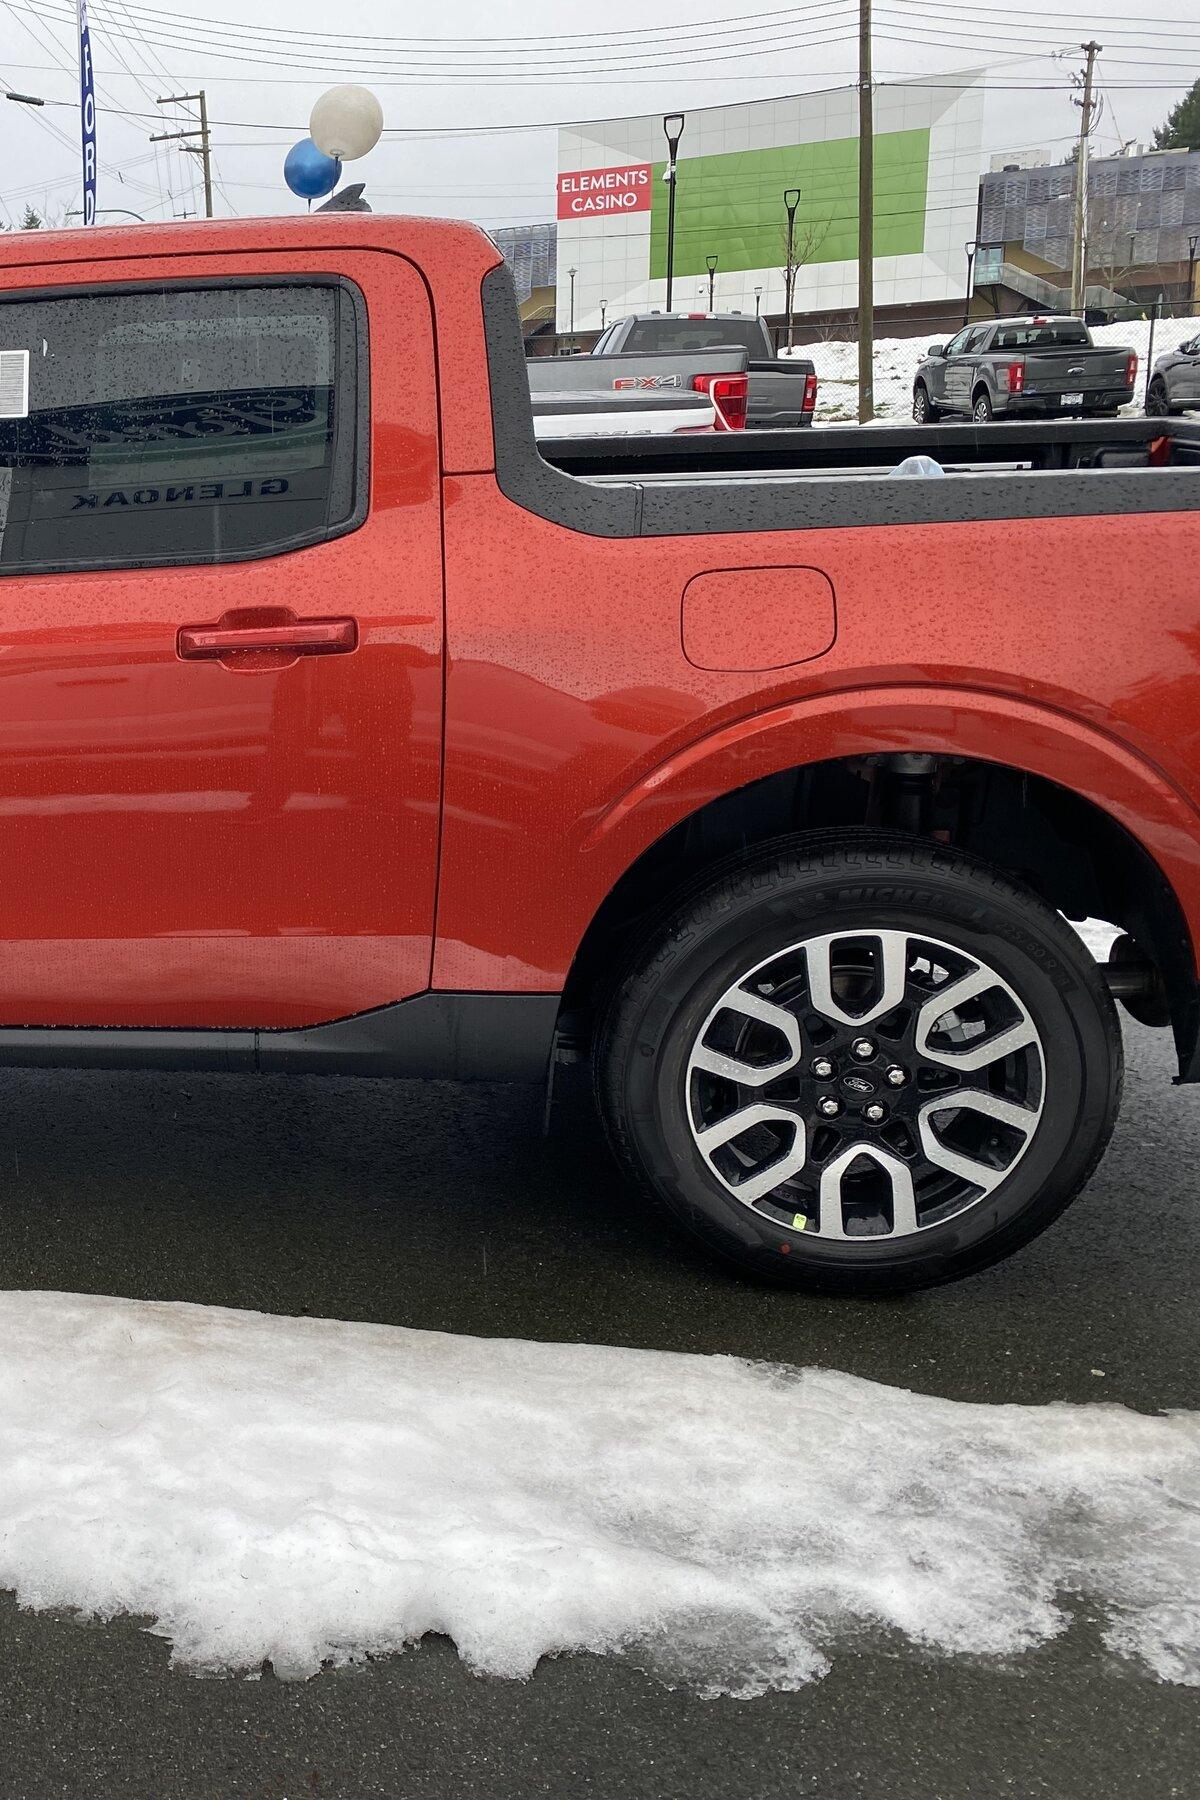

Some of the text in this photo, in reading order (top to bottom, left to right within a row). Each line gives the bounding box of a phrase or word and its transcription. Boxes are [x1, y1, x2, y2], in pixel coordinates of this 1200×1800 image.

[84, 43, 95, 225] FORD
[561, 169, 648, 193] ELEMENTS
[571, 192, 638, 212] CASINO
[612, 374, 681, 390] FX4
